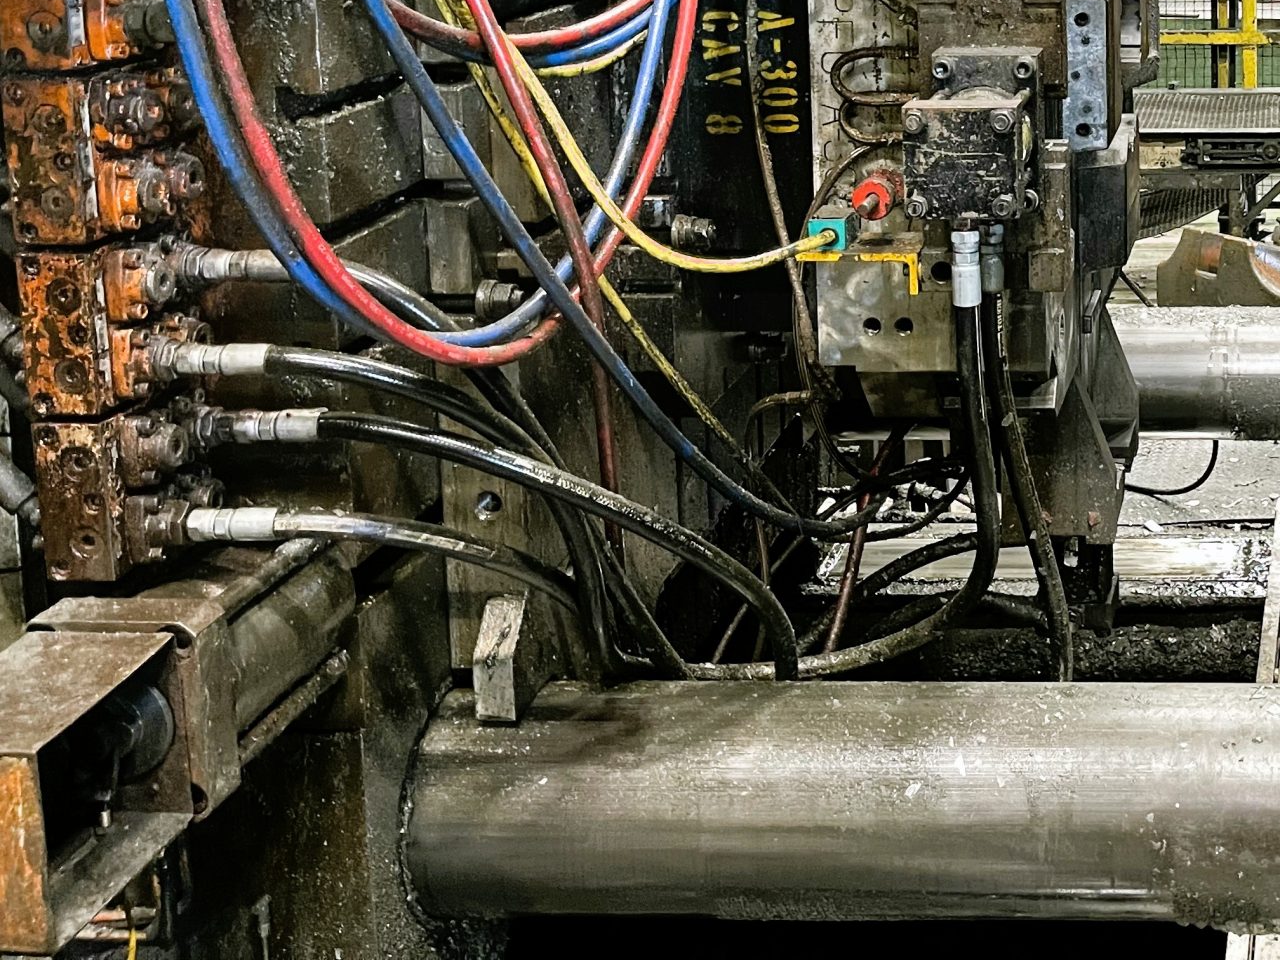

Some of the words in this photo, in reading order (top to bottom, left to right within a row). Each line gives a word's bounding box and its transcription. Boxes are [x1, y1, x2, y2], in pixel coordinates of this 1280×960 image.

[702, 12, 741, 86] CAV
[758, 11, 799, 133] A-300
[706, 114, 743, 134] 8
